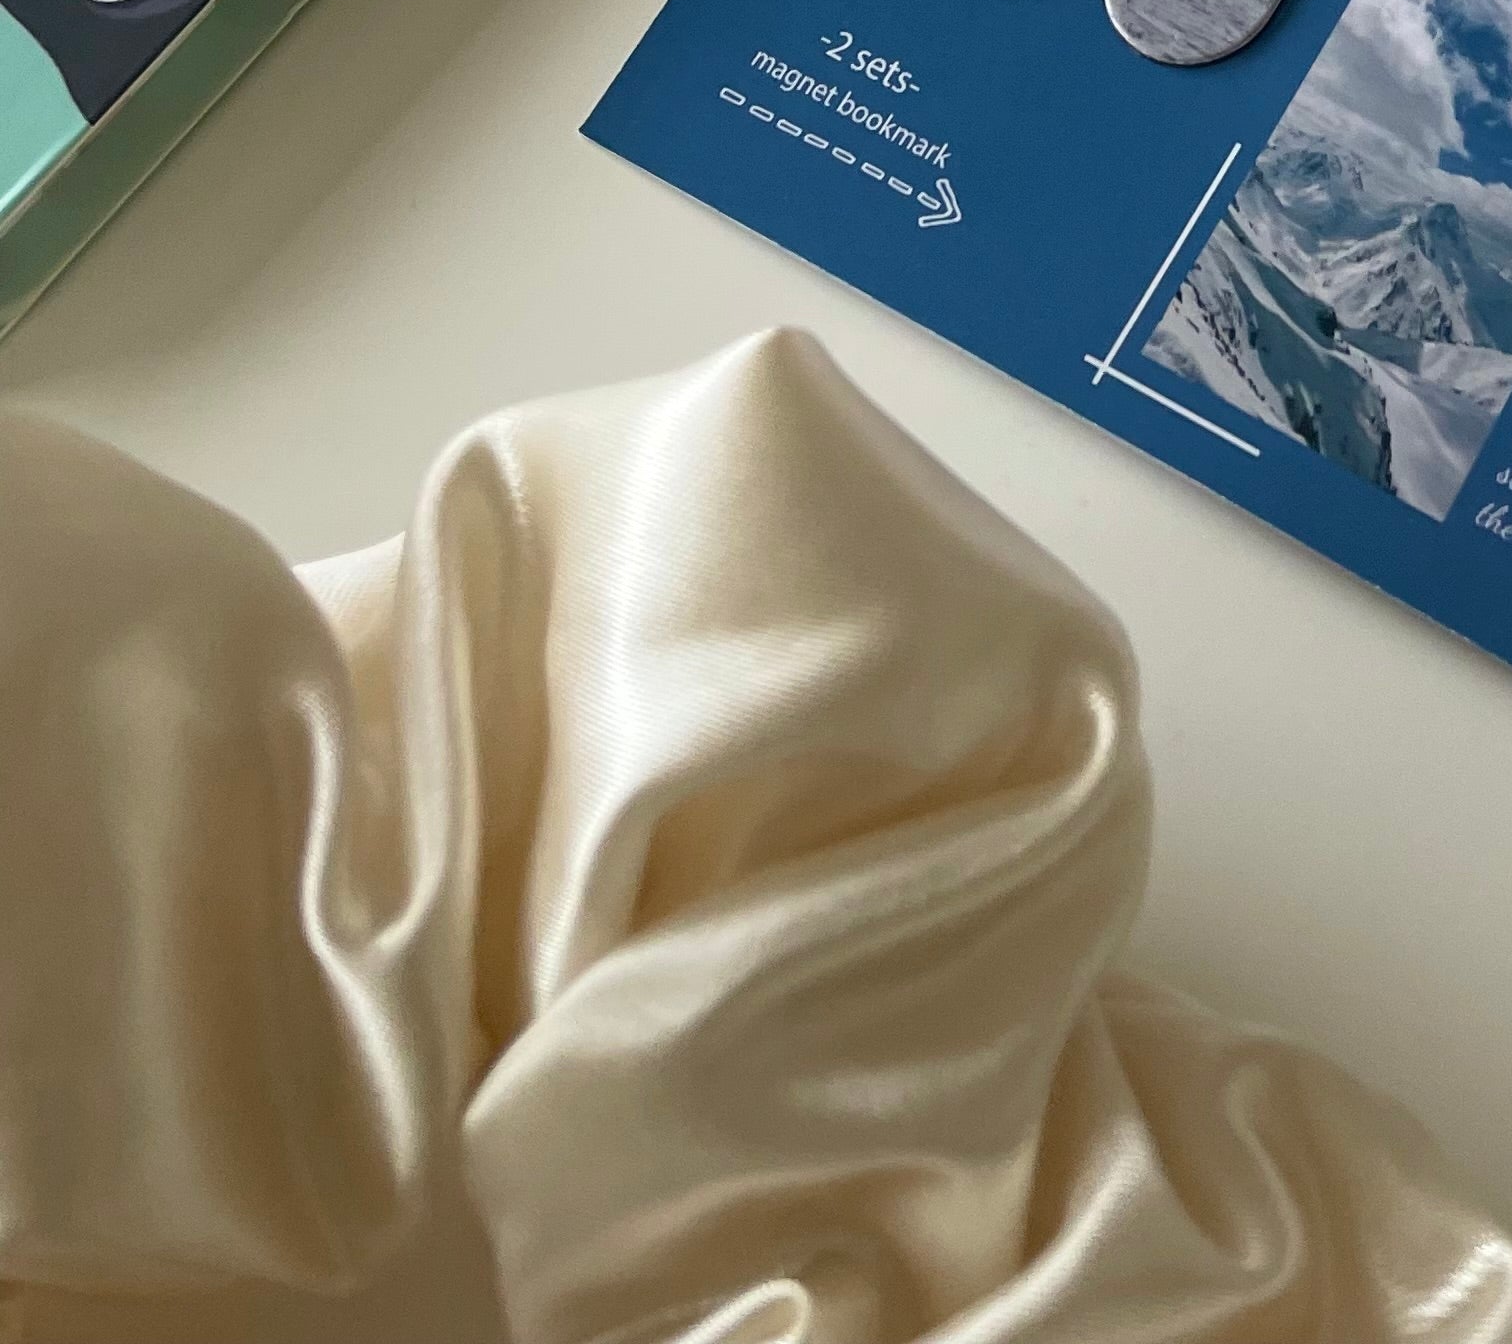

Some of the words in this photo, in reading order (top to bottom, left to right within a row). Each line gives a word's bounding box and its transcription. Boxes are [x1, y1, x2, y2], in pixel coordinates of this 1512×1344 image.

[820, 30, 854, 62] -2
[850, 48, 922, 94] sets-
[751, 50, 840, 108] magnet
[836, 90, 953, 169] bookmark
